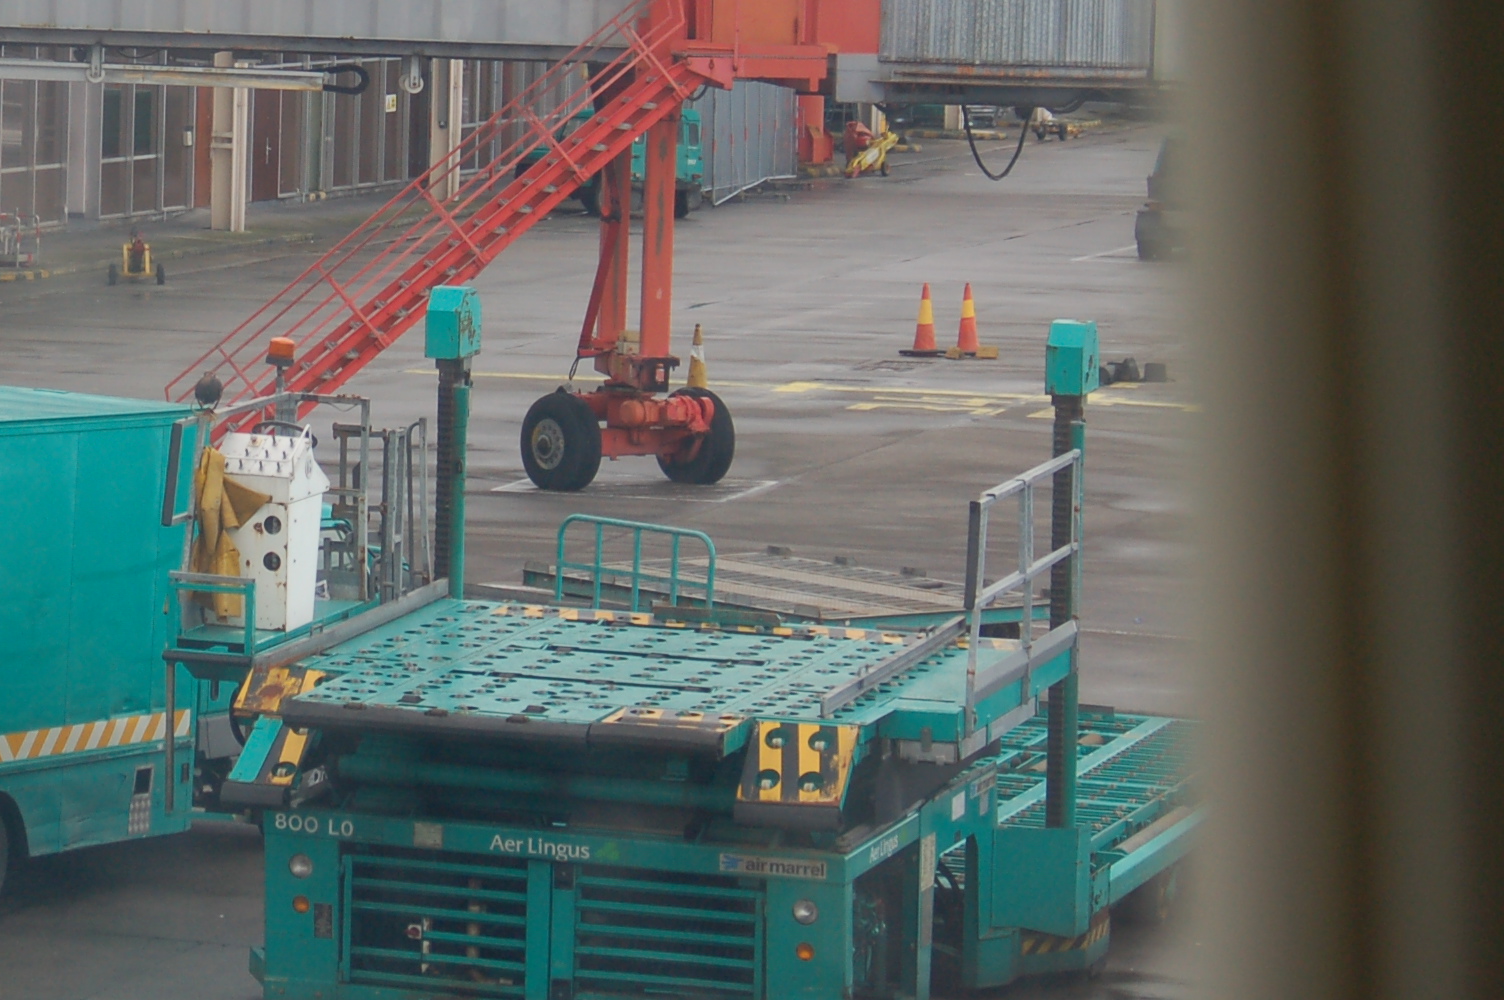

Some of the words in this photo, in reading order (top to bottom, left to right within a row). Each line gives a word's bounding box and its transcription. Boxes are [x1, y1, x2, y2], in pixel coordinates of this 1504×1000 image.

[275, 813, 318, 834] 800
[490, 834, 524, 853] Aer
[527, 837, 591, 861] Lingus
